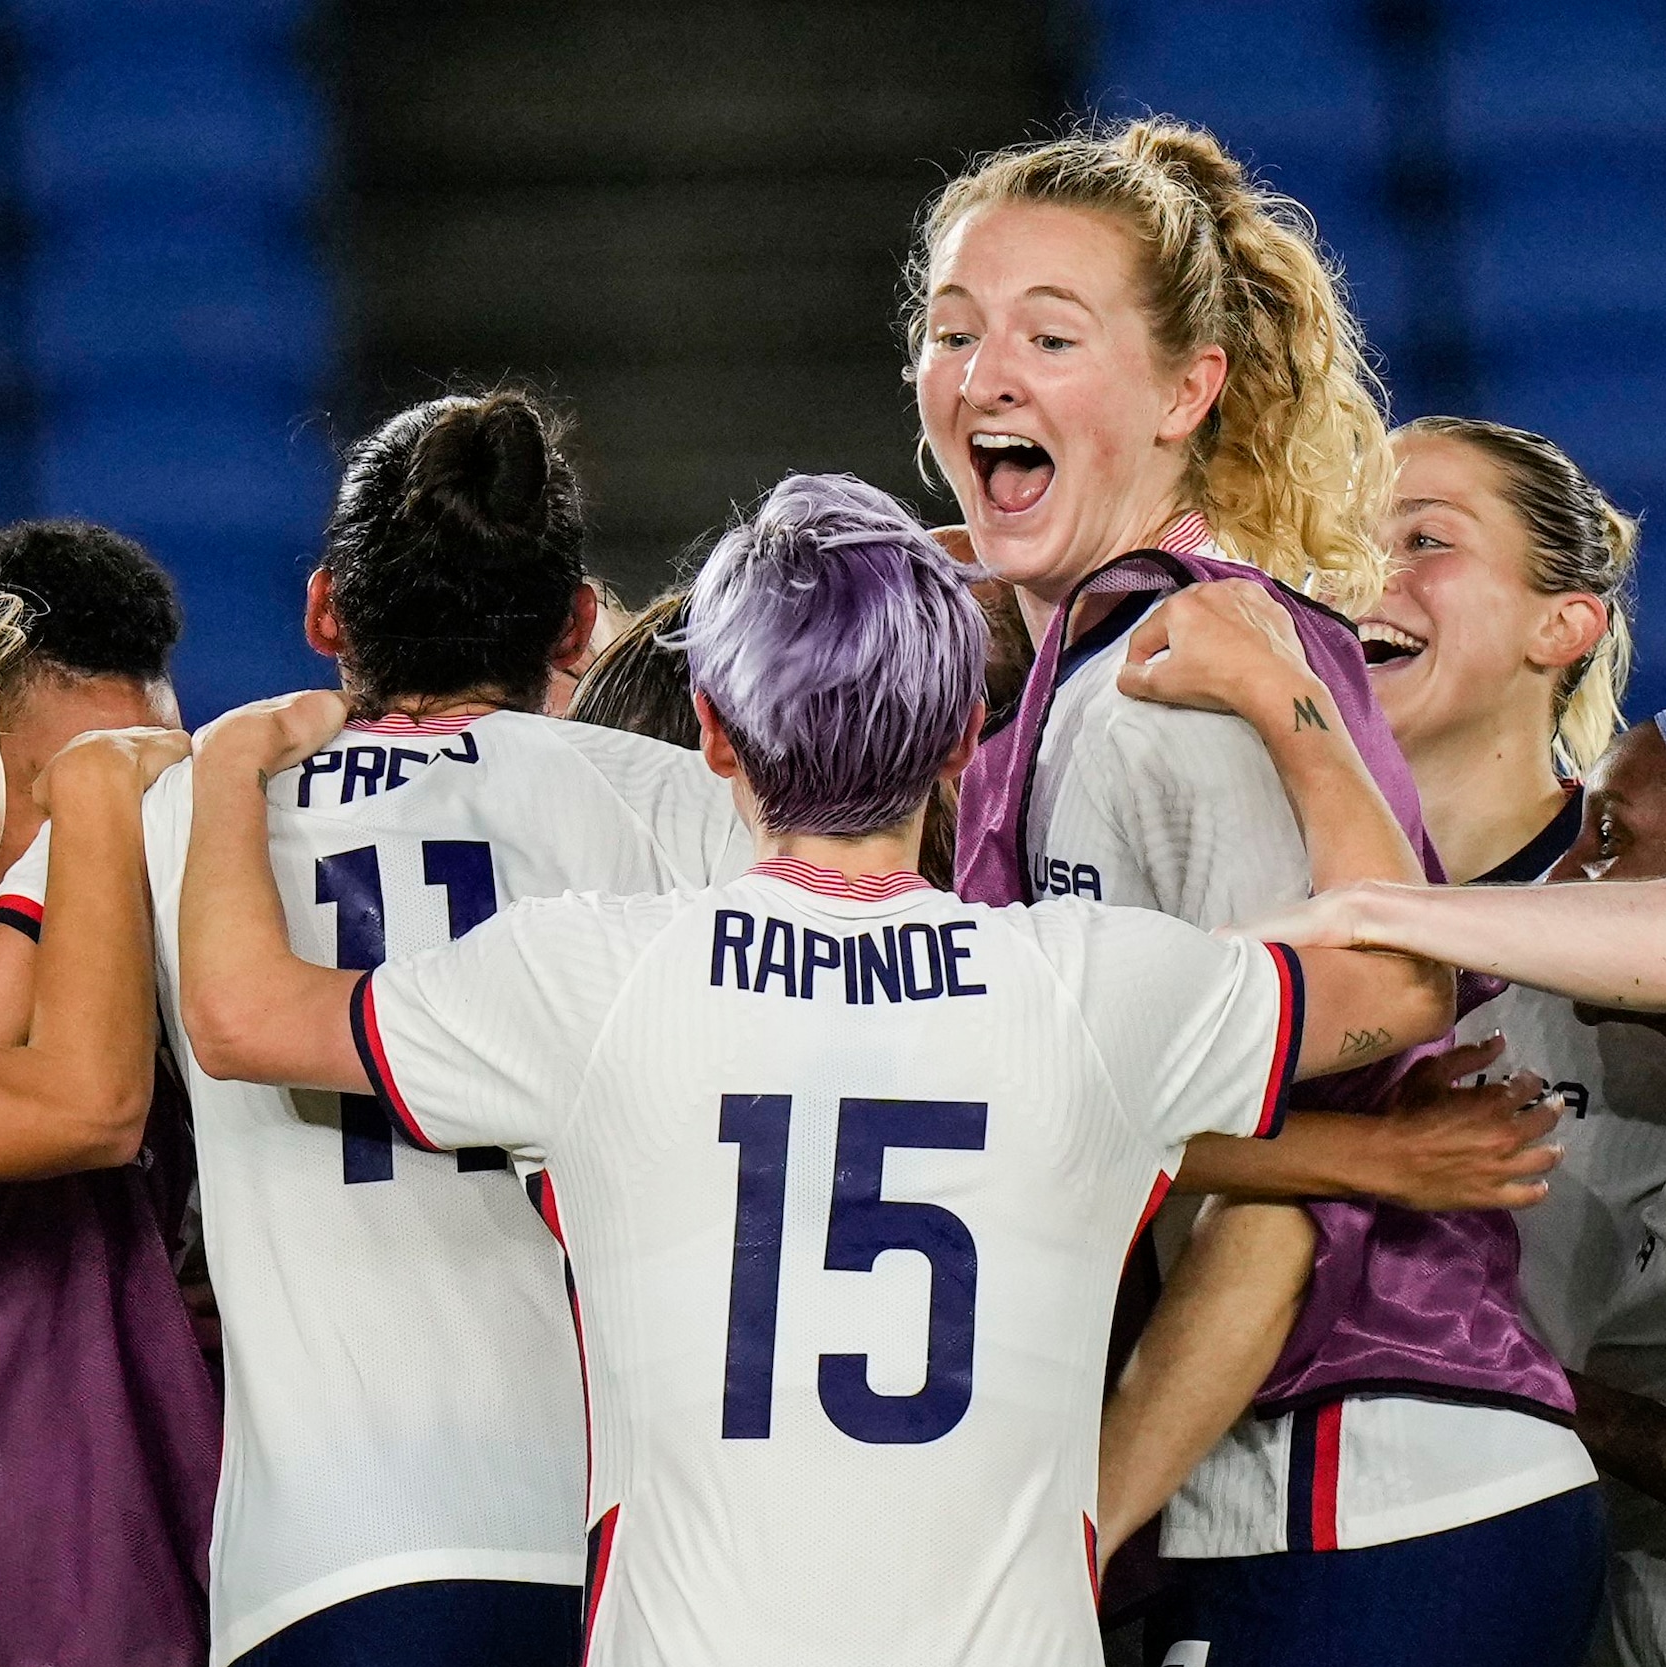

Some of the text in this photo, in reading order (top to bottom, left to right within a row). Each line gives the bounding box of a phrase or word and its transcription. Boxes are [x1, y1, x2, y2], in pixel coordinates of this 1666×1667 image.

[297, 731, 480, 808] PRE
[1034, 852, 1102, 901] USA
[710, 909, 987, 1005] RAPINOE
[718, 1093, 988, 1445] 15
